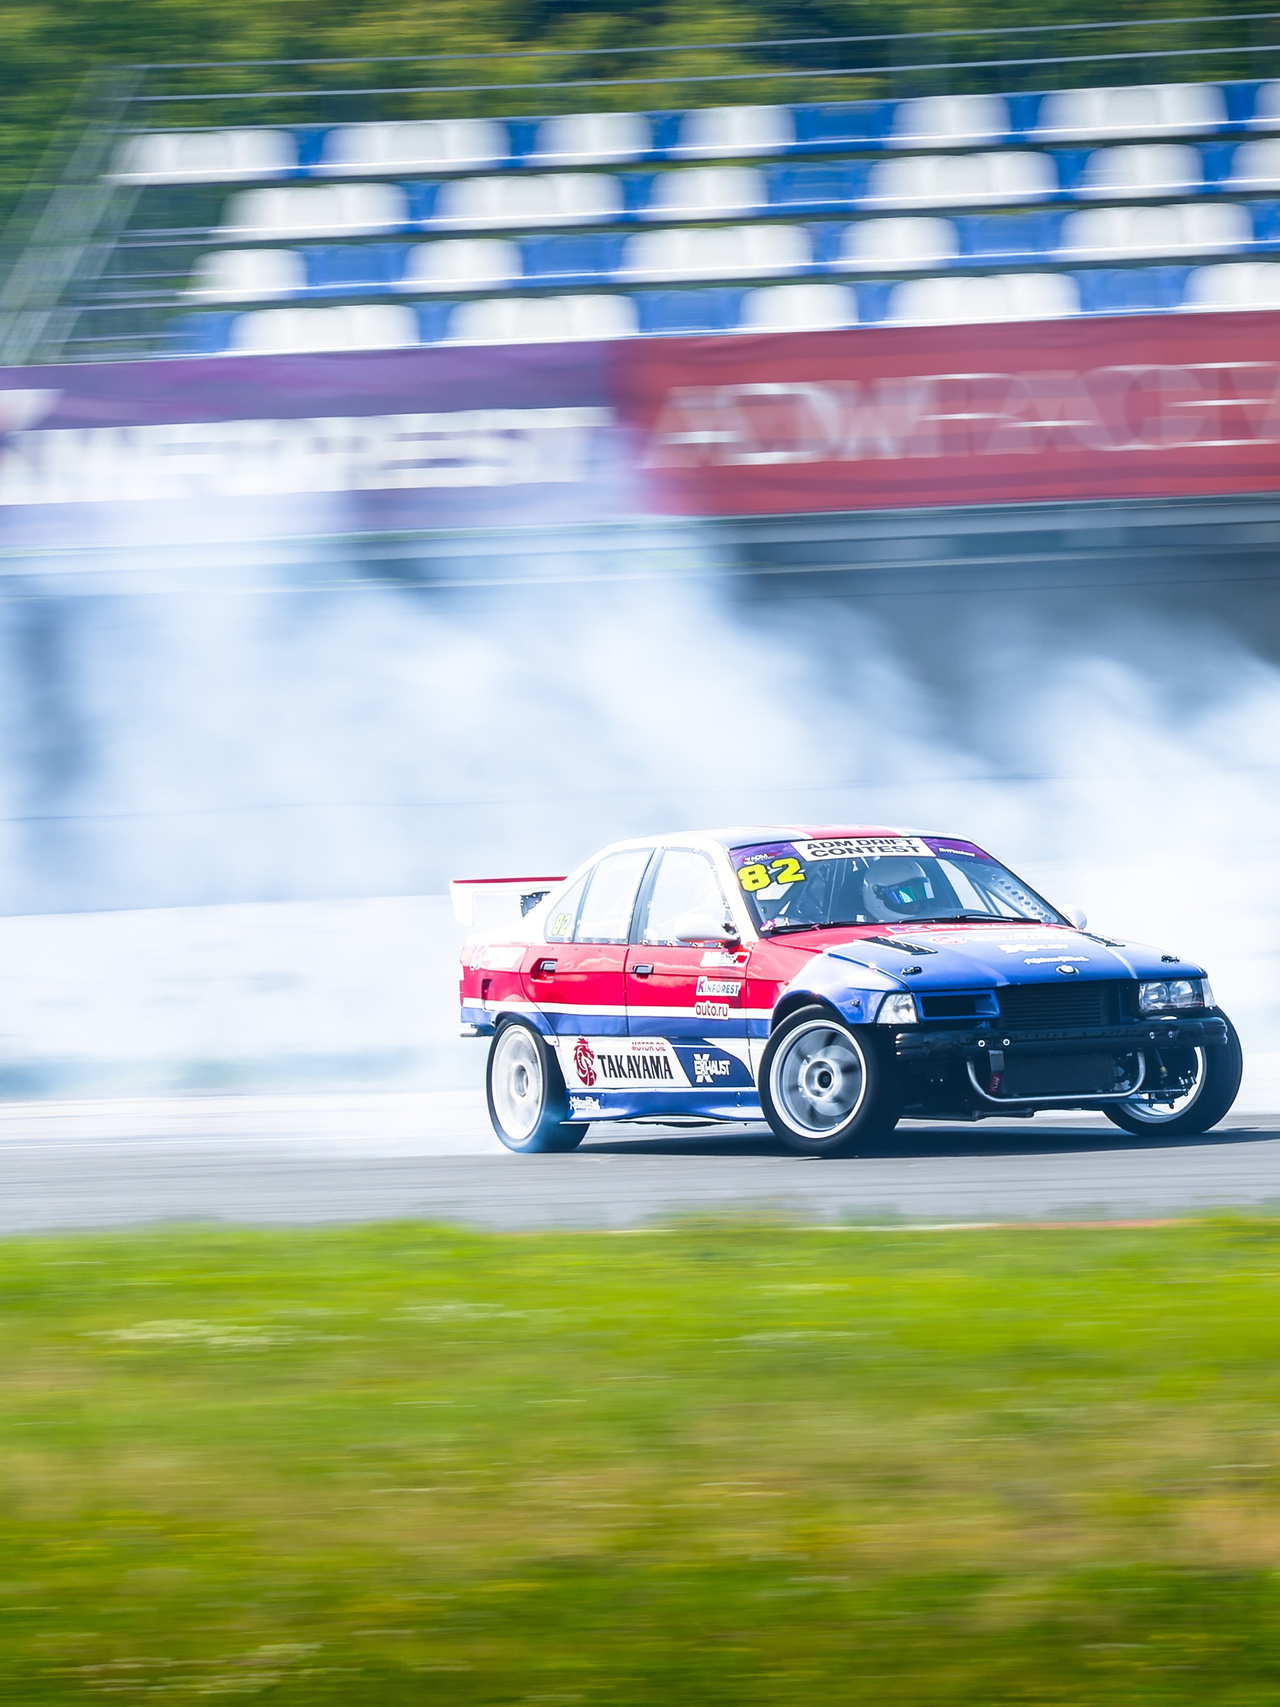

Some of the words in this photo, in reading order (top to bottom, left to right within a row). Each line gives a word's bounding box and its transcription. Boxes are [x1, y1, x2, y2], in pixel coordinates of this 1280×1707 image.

[807, 839, 854, 850] ADM
[857, 838, 914, 847] DRIFT
[811, 845, 920, 858] CONTEST
[737, 857, 805, 892] 82
[551, 913, 572, 936] 82
[698, 979, 739, 994] KINFOREST
[696, 1003, 728, 1017] auto.ru
[631, 1041, 654, 1052] MOTOR
[655, 1041, 667, 1052] OIL
[597, 1055, 674, 1080] TAKAYAMA
[693, 1053, 730, 1083] EXHAUST
